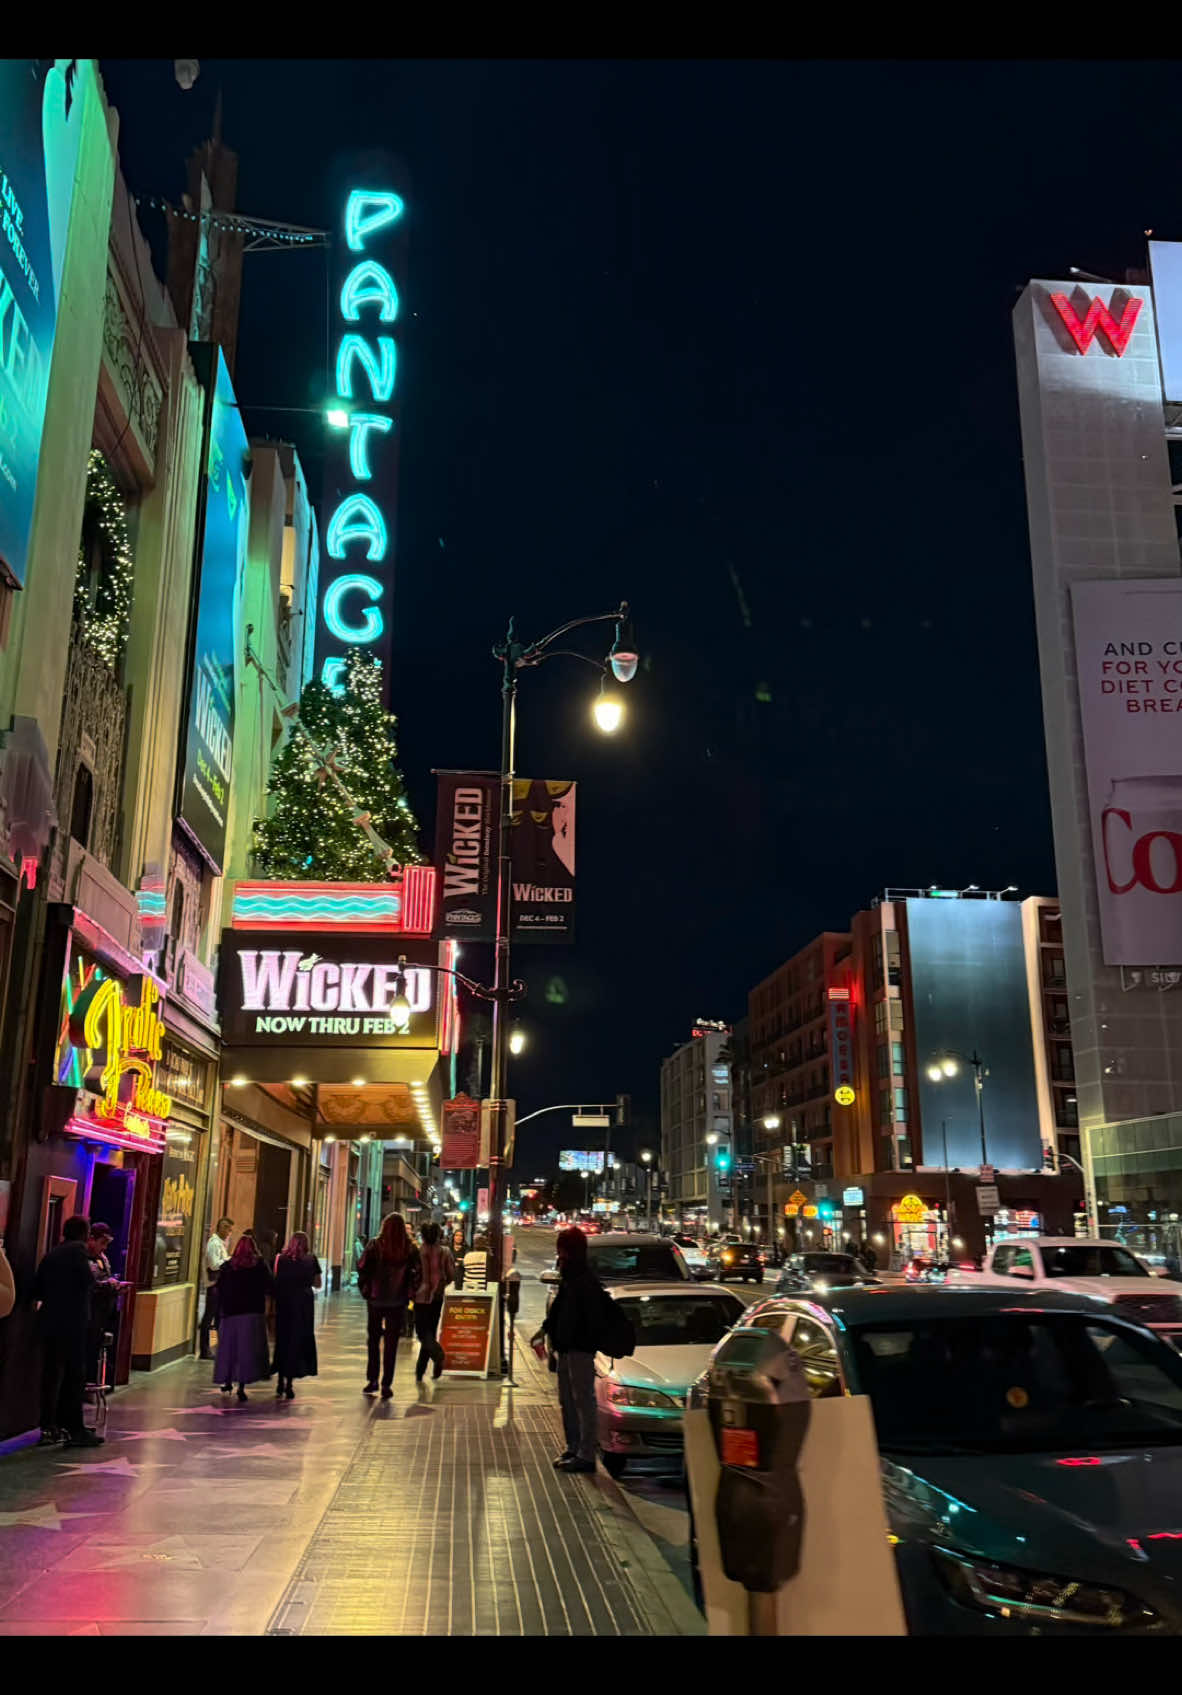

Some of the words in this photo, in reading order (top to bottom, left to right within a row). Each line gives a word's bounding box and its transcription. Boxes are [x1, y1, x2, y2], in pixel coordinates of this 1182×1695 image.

[1050, 290, 1144, 358] W
[1104, 642, 1152, 656] AND
[1102, 661, 1148, 675] FOR
[1101, 680, 1153, 694] DIET
[256, 1016, 306, 1034] NOW
[308, 1016, 360, 1035] THRU
[363, 1016, 396, 1035] FEB
